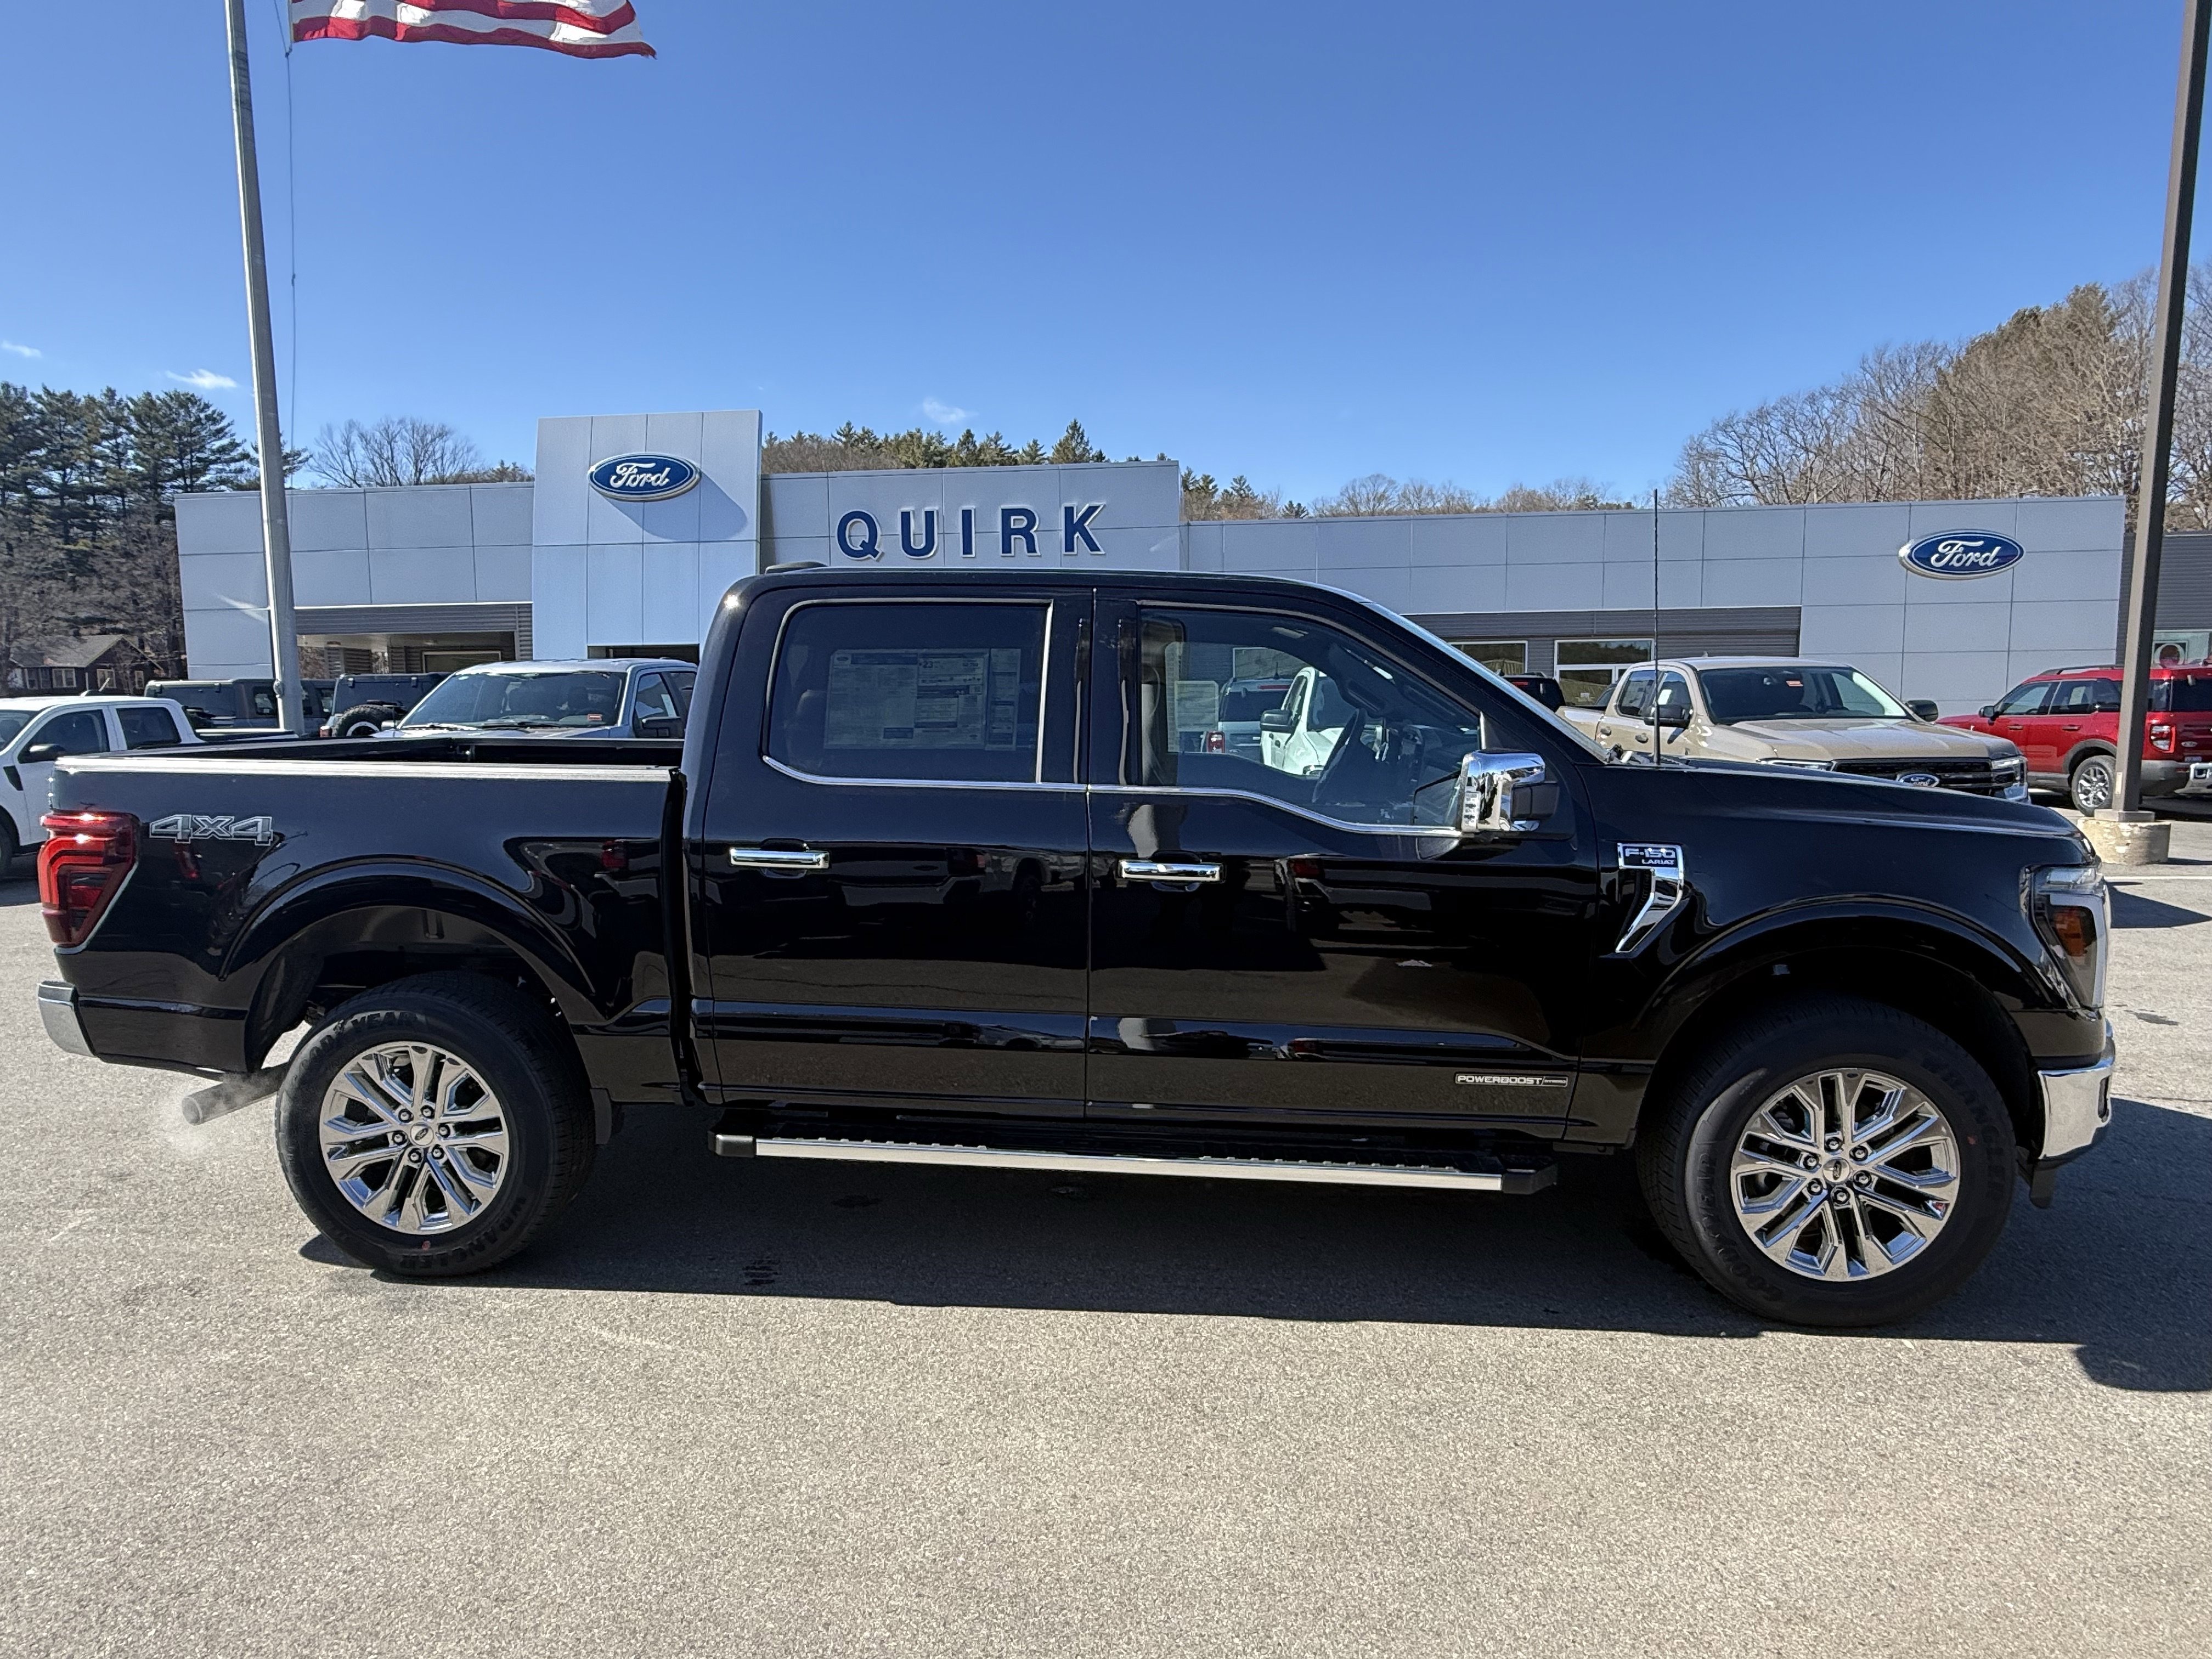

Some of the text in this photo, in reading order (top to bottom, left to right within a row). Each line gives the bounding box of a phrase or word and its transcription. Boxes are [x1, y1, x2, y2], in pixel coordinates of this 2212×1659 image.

[610, 462, 671, 488] Ford
[836, 503, 1106, 560] QUIRK
[1931, 540, 2001, 567] Ford
[1624, 848, 1675, 859] F-150
[1457, 1075, 1543, 1085] POWERBOOST
